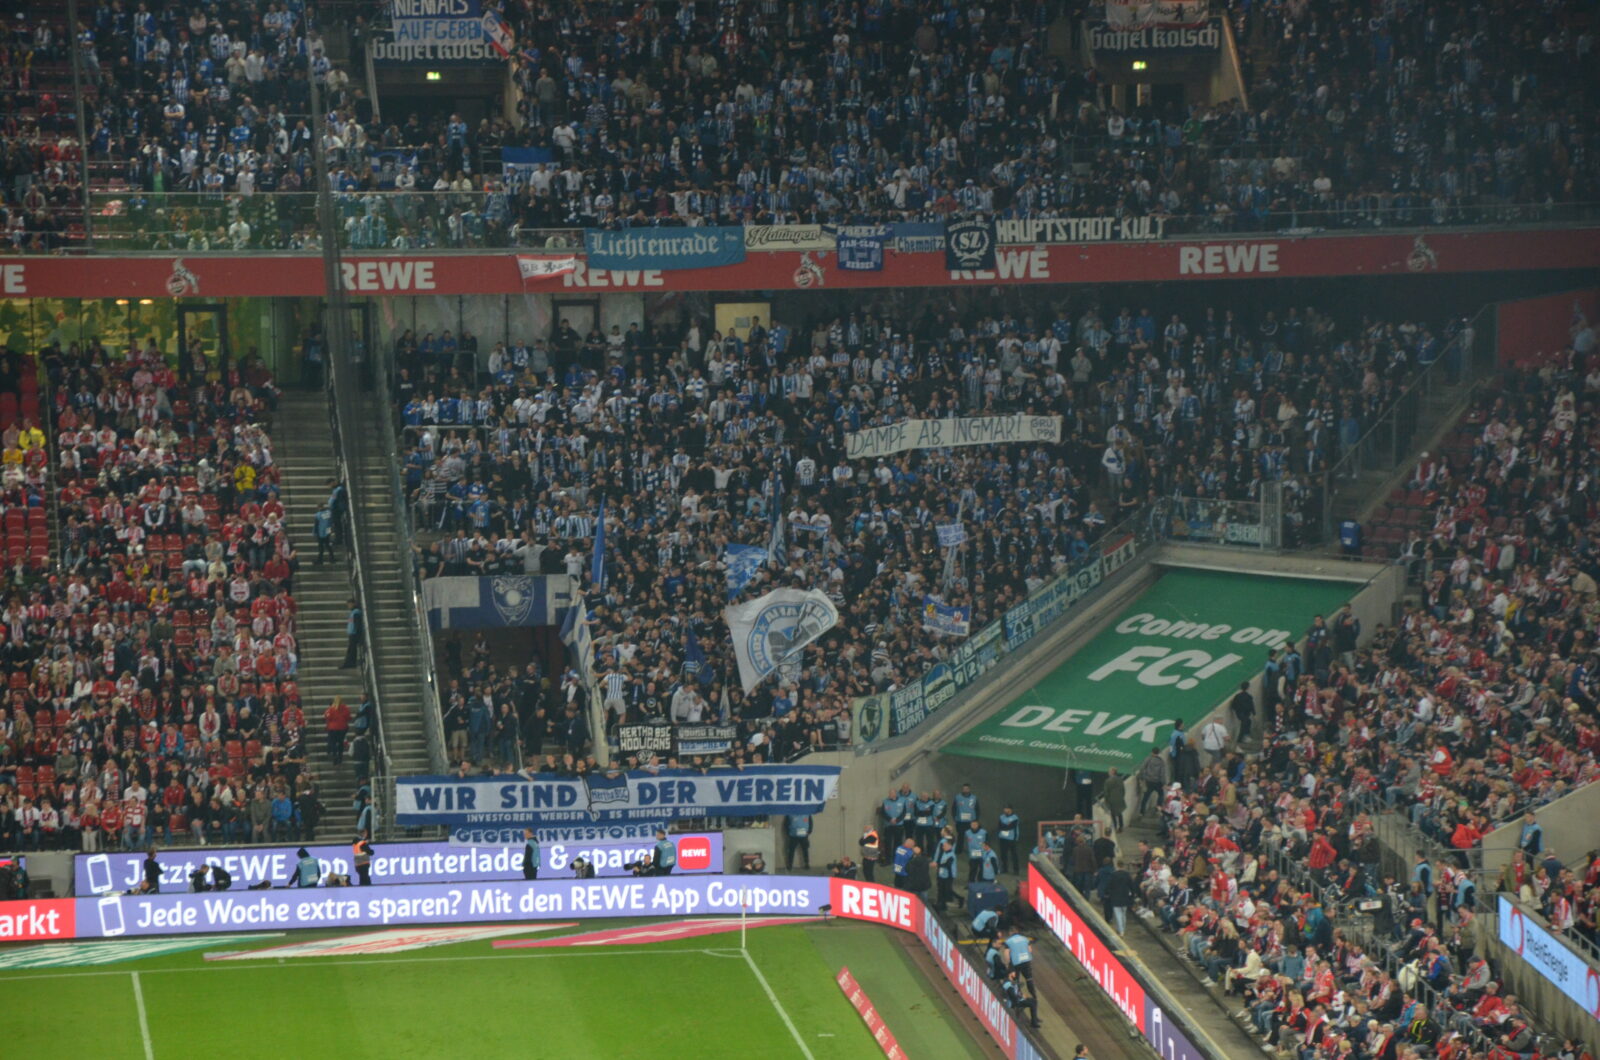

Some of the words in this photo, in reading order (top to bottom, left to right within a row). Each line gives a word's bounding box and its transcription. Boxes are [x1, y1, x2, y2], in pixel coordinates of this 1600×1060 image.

[960, 231, 980, 249] SZ
[995, 216, 1167, 243] HAUPTSTADT-KULT
[591, 231, 720, 260] Lichtenrade
[1179, 244, 1279, 274] REWE
[334, 261, 436, 290] REWE
[952, 415, 1021, 444] INGMAR!
[1115, 613, 1232, 641] Come
[1087, 645, 1244, 690] FC!
[620, 726, 654, 738] HERTHA
[1000, 705, 1178, 743] DEVK
[620, 737, 671, 751] HOOLIGANS
[413, 786, 476, 811] WIR
[500, 783, 578, 809] SIND
[637, 780, 697, 806] DER
[715, 777, 825, 803] VEREIN
[467, 812, 533, 823] INVESTOREN
[540, 810, 584, 821] WERDEN
[609, 810, 622, 819] ES
[628, 807, 673, 819] NIEMALS
[455, 827, 526, 844] GEGEN
[538, 822, 667, 843] INVESTOREN
[124, 858, 195, 886] Jtzt
[549, 844, 568, 870] &
[681, 848, 707, 858] REWE
[136, 901, 197, 928] Jede
[204, 897, 289, 924] Woche
[296, 897, 360, 921] extra
[368, 890, 462, 924] sparen?
[469, 888, 512, 914] Mit
[519, 887, 562, 913] den
[571, 884, 645, 911] REWE
[651, 883, 699, 914] App
[706, 881, 810, 912] Coupons
[841, 884, 911, 927] REWE
